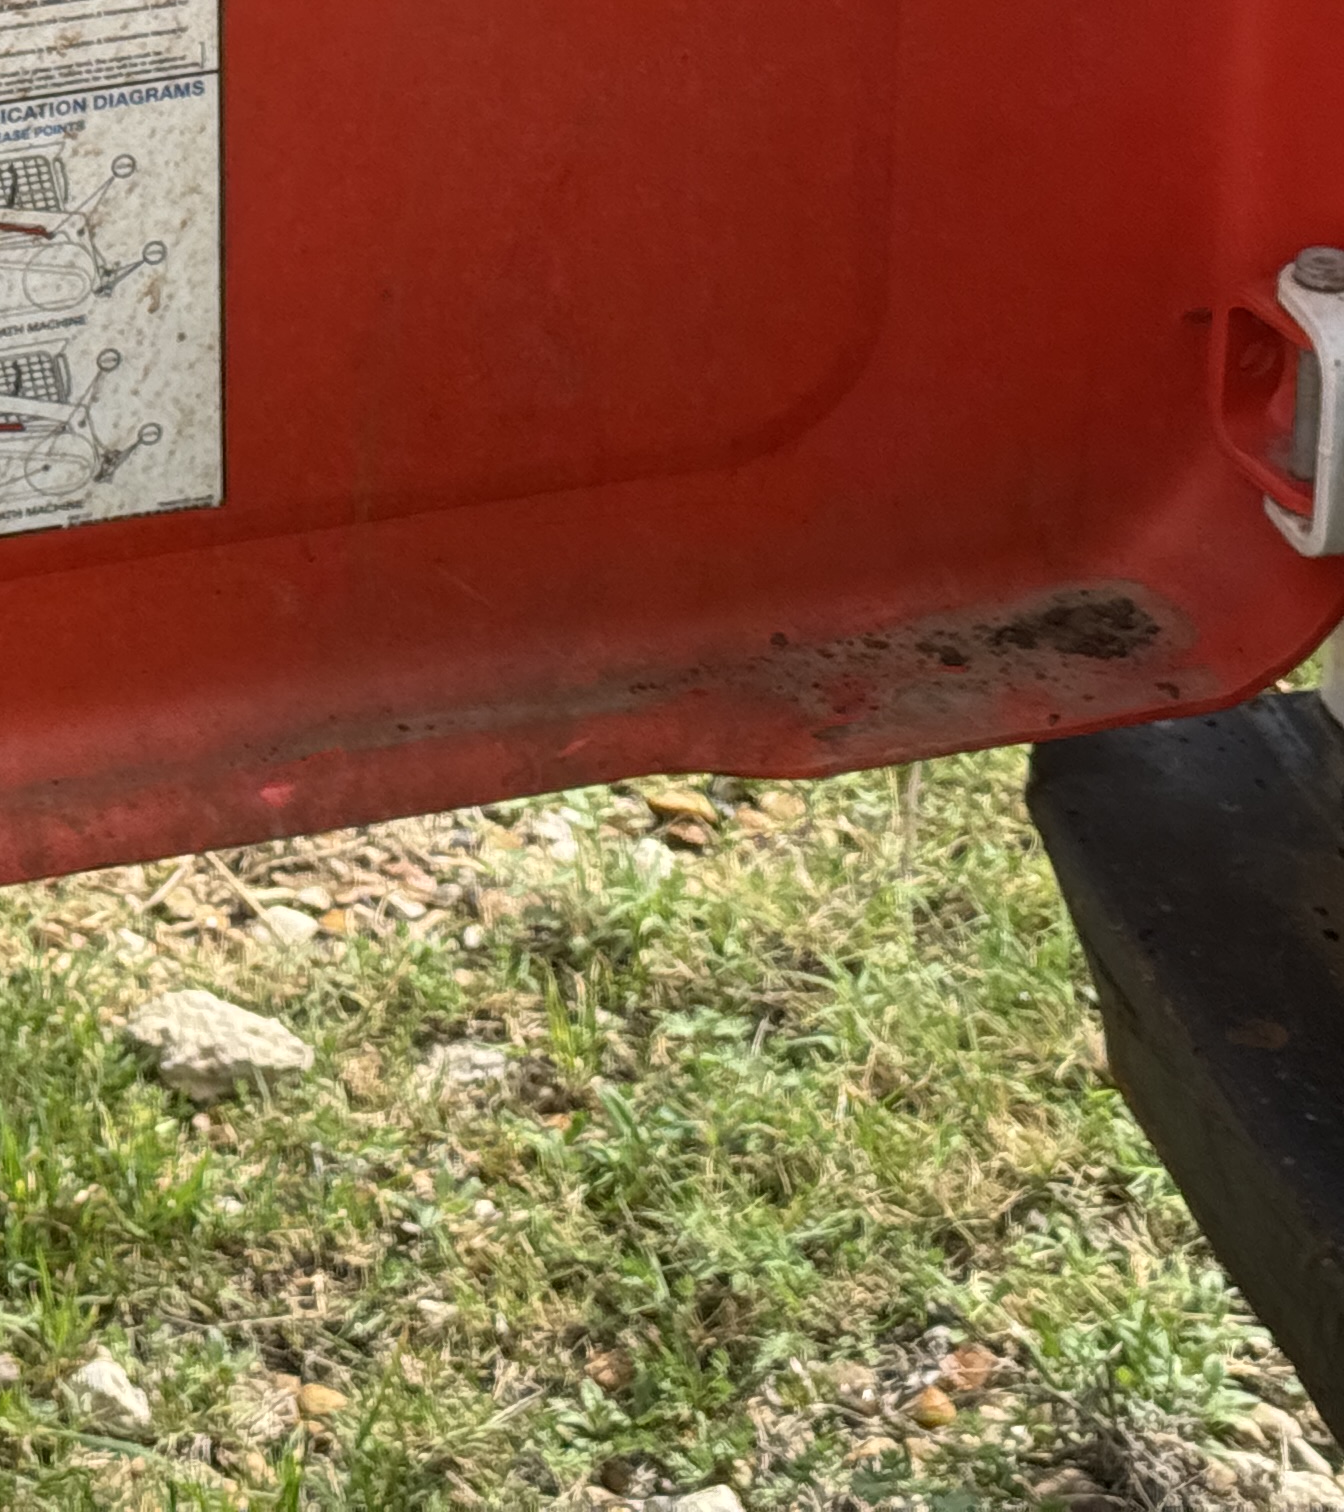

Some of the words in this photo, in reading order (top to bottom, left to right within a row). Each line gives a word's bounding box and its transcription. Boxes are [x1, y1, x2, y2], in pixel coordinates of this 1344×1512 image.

[93, 79, 204, 111] DIAGRAMS
[33, 119, 85, 138] POINTS
[27, 314, 86, 334] MACHINE
[26, 498, 84, 517] MACHINE
